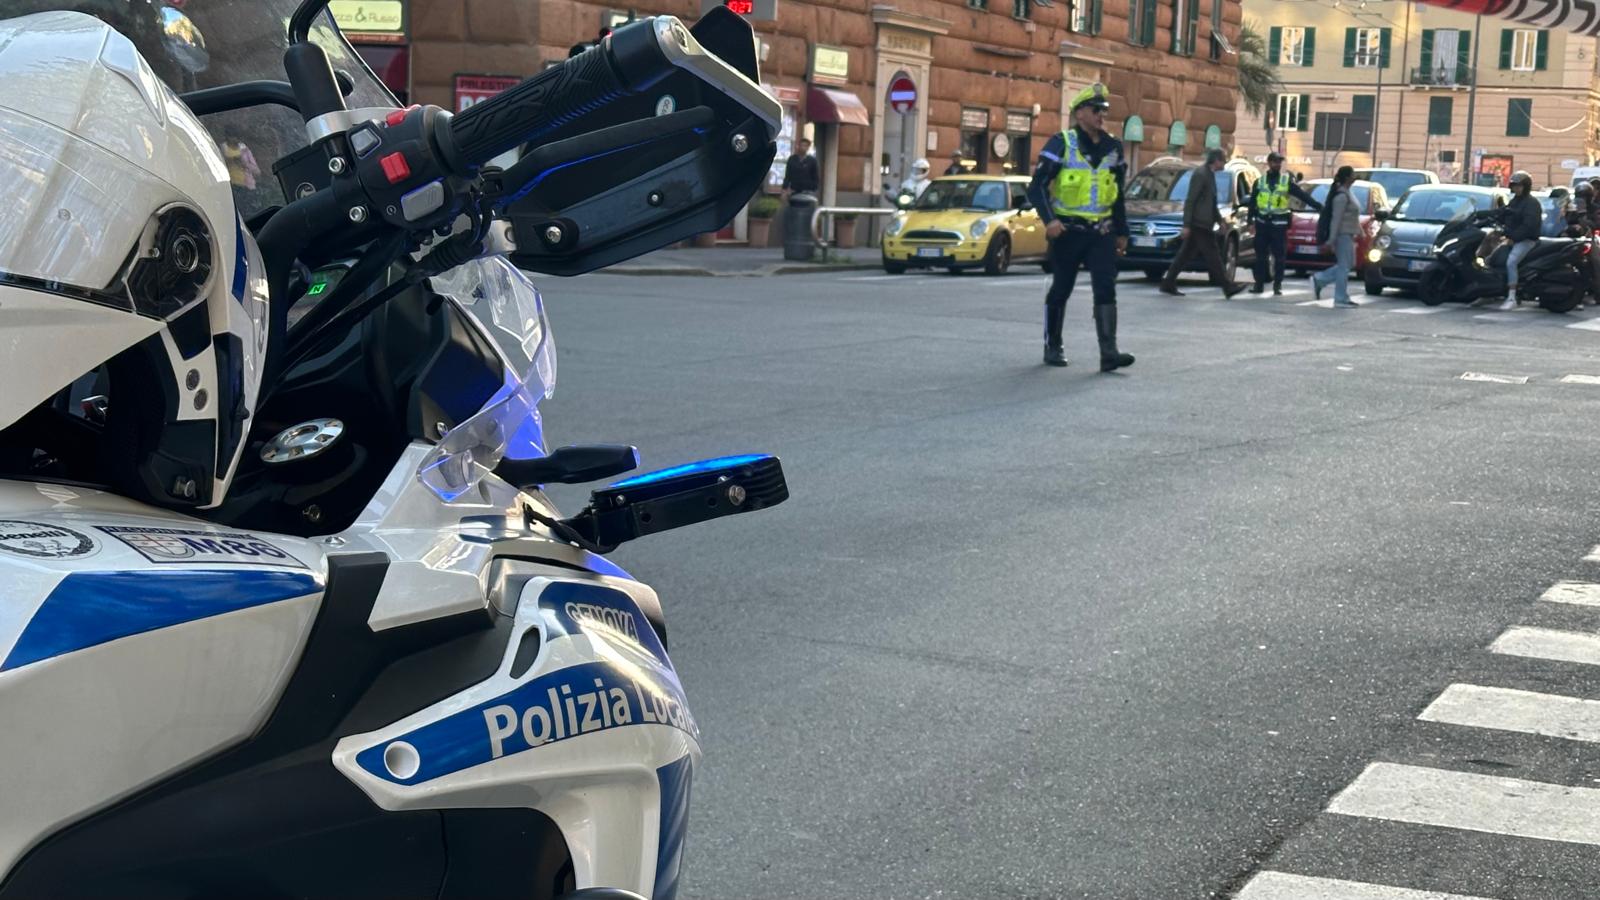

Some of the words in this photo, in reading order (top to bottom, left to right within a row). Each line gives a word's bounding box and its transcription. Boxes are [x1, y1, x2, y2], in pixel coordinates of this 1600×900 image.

[178, 537, 286, 559] M86
[565, 602, 639, 645] GENOVA
[483, 678, 632, 759] Polizia
